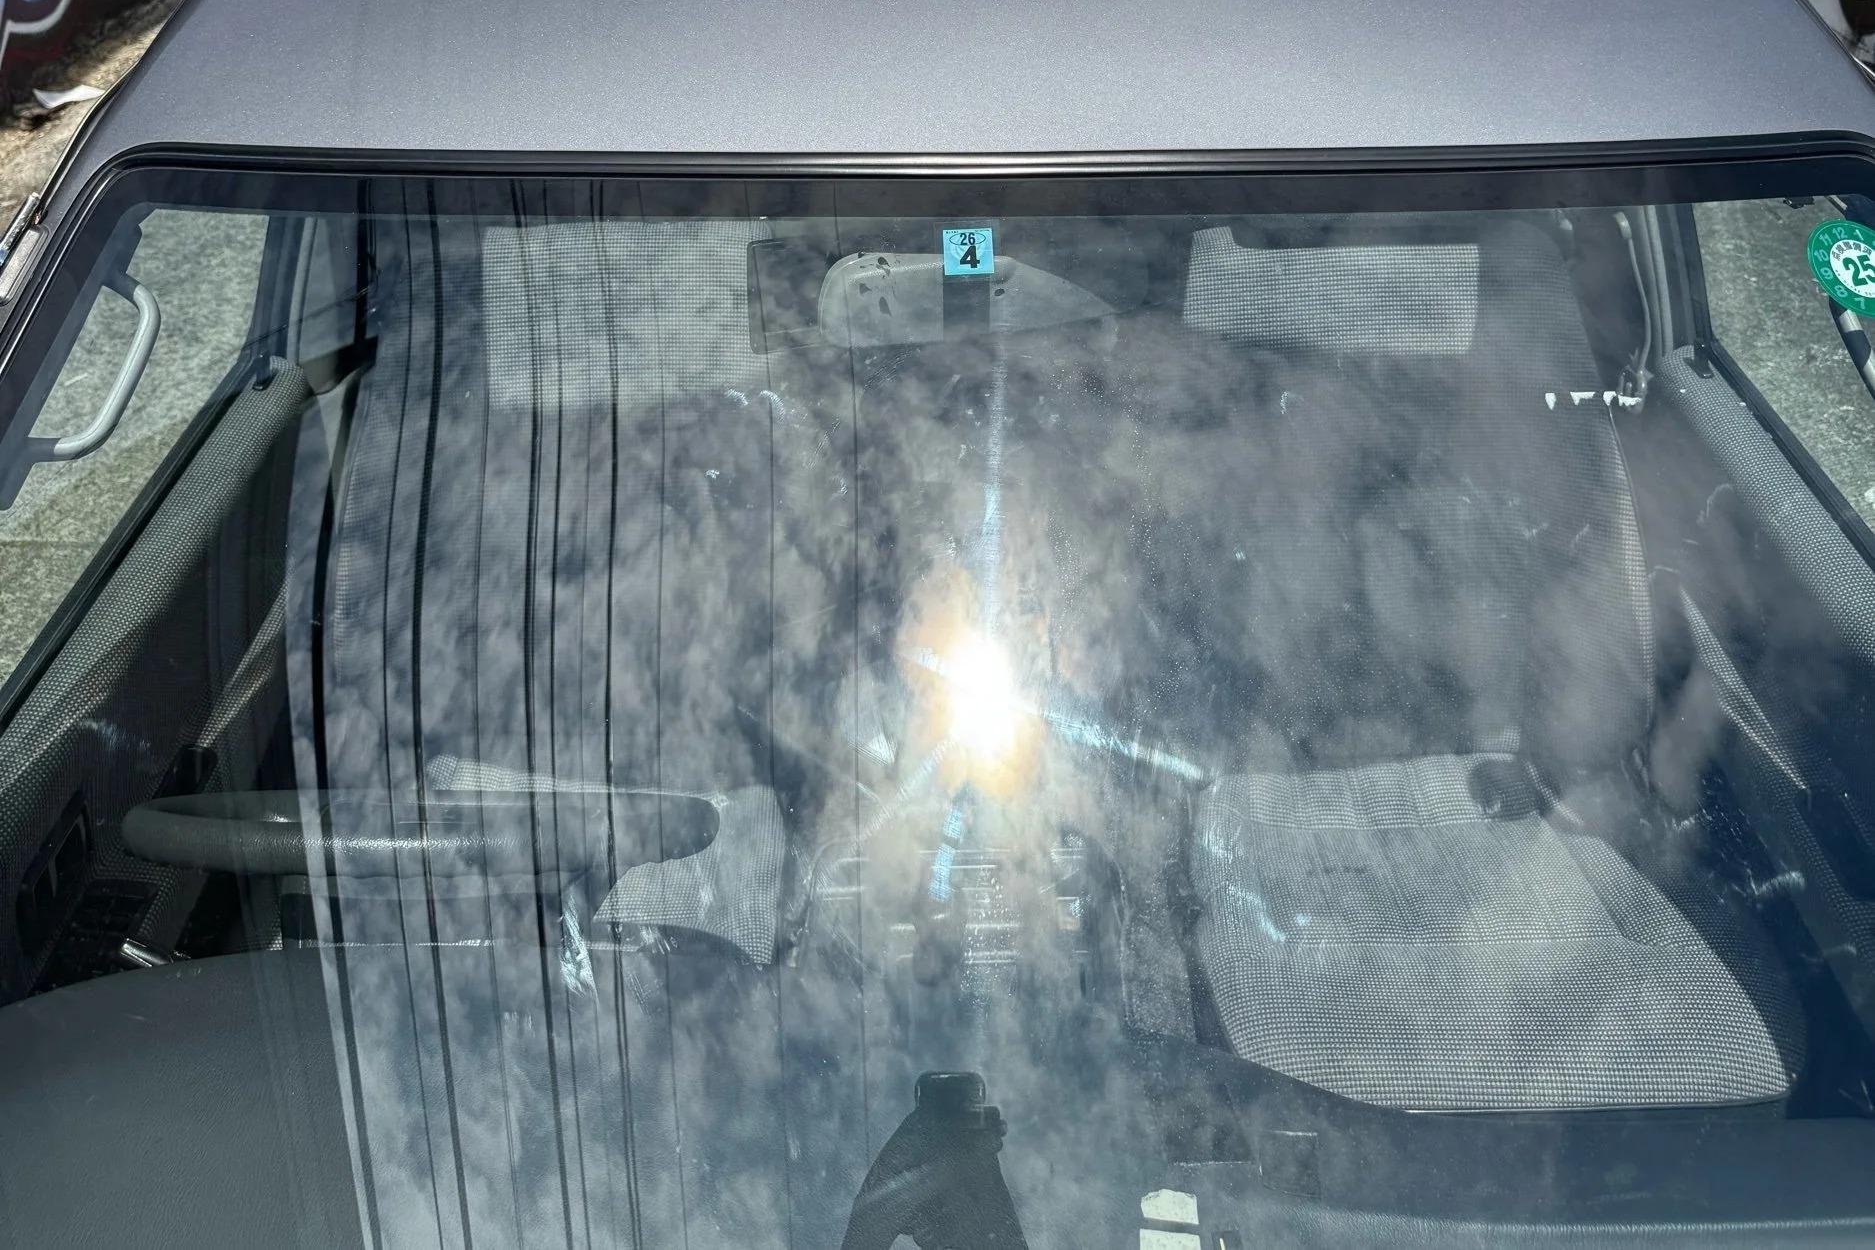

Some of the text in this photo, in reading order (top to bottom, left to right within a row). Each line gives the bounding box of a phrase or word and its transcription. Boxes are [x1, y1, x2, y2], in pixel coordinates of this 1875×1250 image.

[959, 232, 976, 246] 26
[1818, 233, 1833, 246] 11
[1832, 227, 1848, 240] 12
[1853, 229, 1864, 241] 1
[959, 245, 980, 269] 4
[1814, 250, 1829, 262] 10
[1820, 267, 1834, 280] 9
[1842, 254, 1875, 287] 25
[1834, 285, 1848, 298] 8
[1853, 297, 1866, 310] 7
